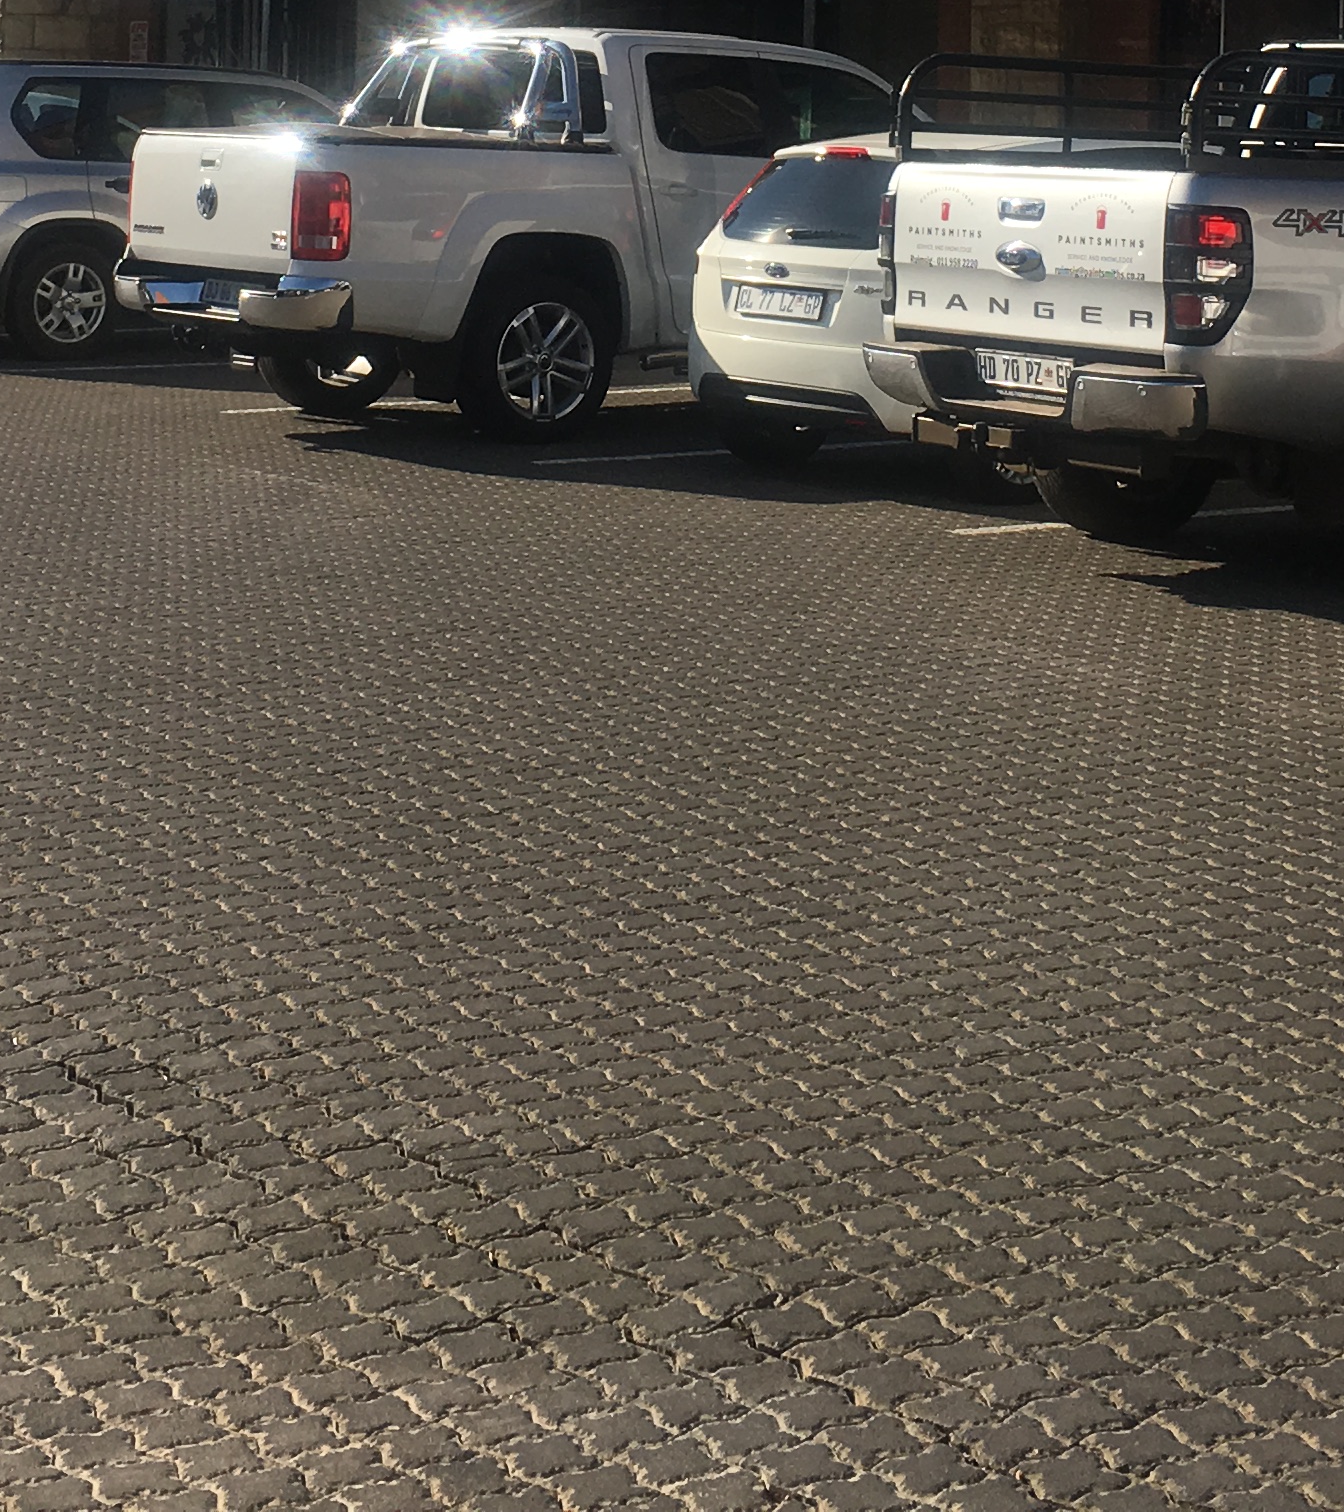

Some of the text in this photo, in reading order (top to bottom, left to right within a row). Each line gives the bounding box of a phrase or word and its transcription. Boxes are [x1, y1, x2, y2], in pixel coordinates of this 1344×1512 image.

[908, 226, 982, 239] PAINTSMITHS
[1057, 235, 1145, 248] PAINTSMITHS
[739, 289, 823, 315] CL 77 LZ GP
[907, 289, 1154, 331] RANGER
[978, 355, 1071, 388] HD 70 PZ GP
